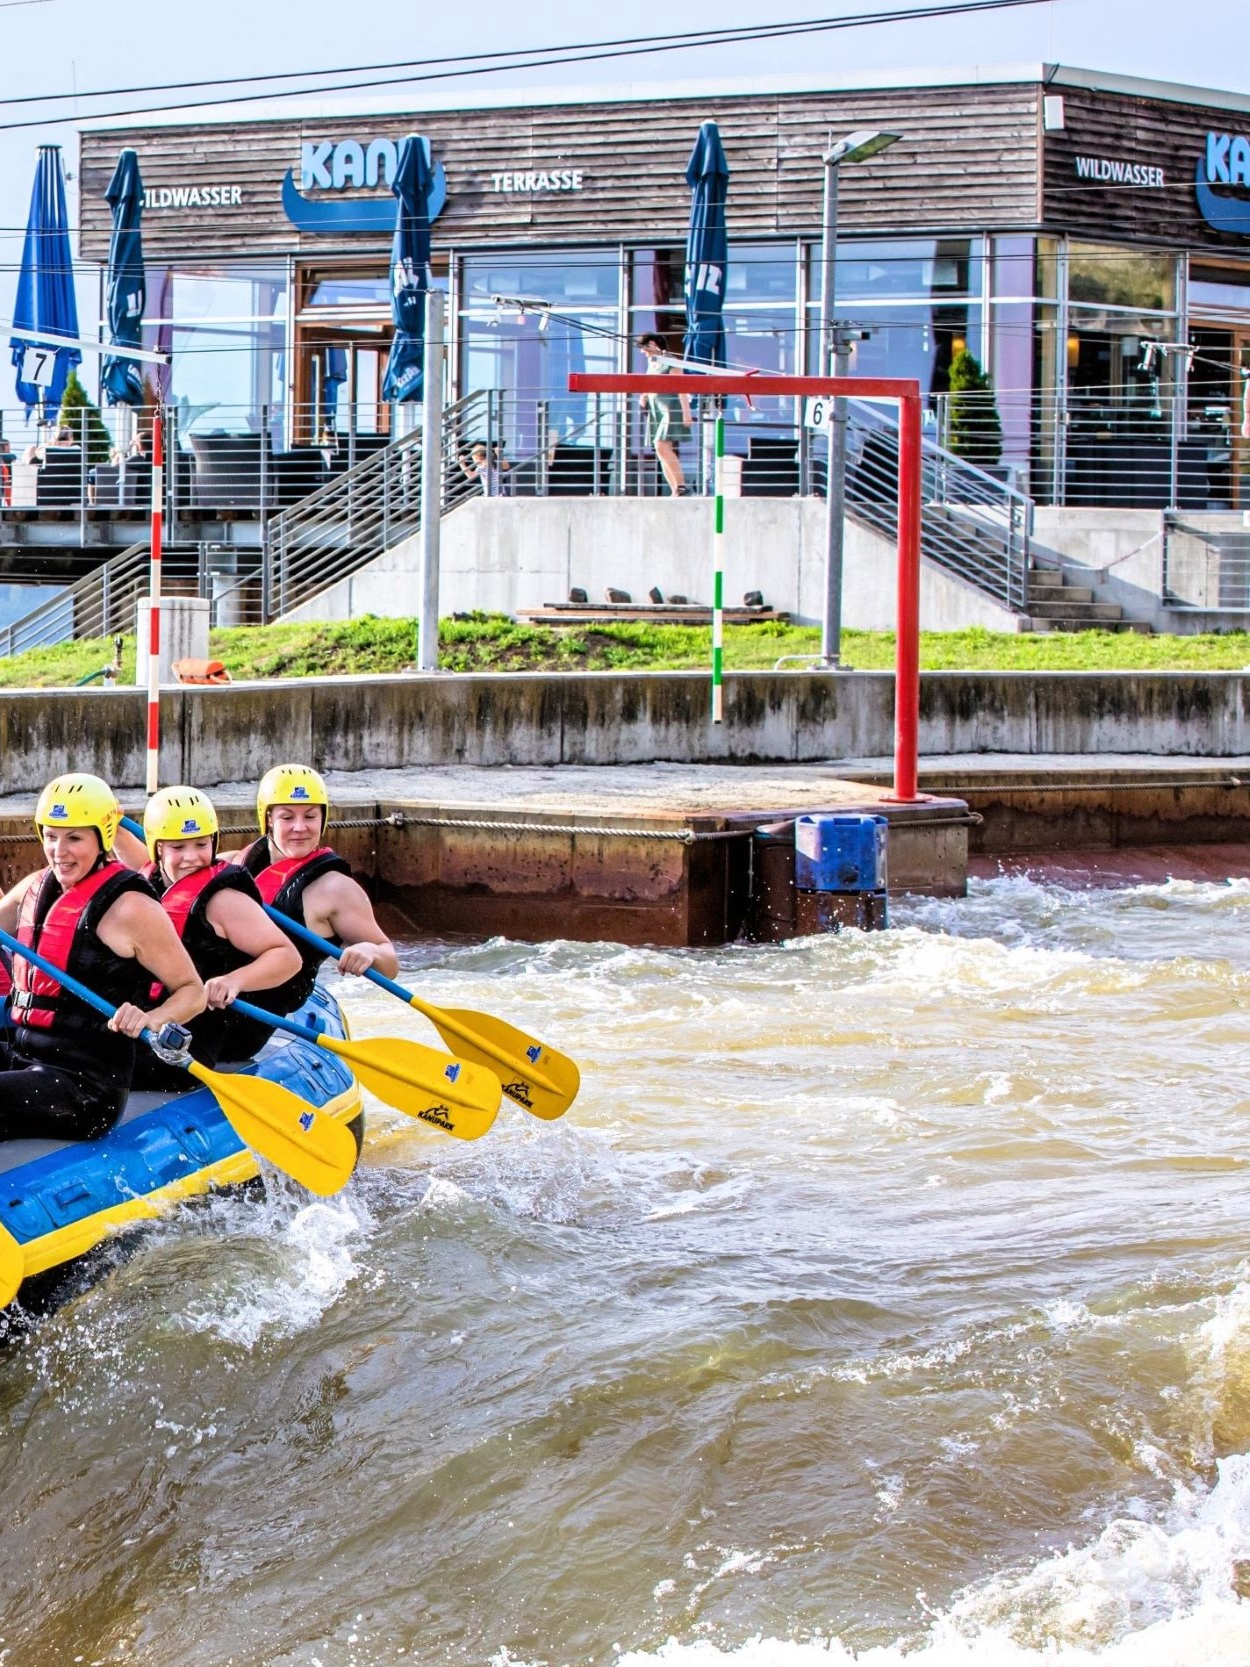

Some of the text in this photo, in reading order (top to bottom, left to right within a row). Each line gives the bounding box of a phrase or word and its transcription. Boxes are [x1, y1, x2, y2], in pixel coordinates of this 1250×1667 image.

[491, 170, 583, 192] TERRASSE
[1076, 156, 1165, 188] WILDWASSER
[33, 352, 47, 381] 7
[813, 402, 823, 425] 6
[417, 1110, 455, 1132] KANUPARK
